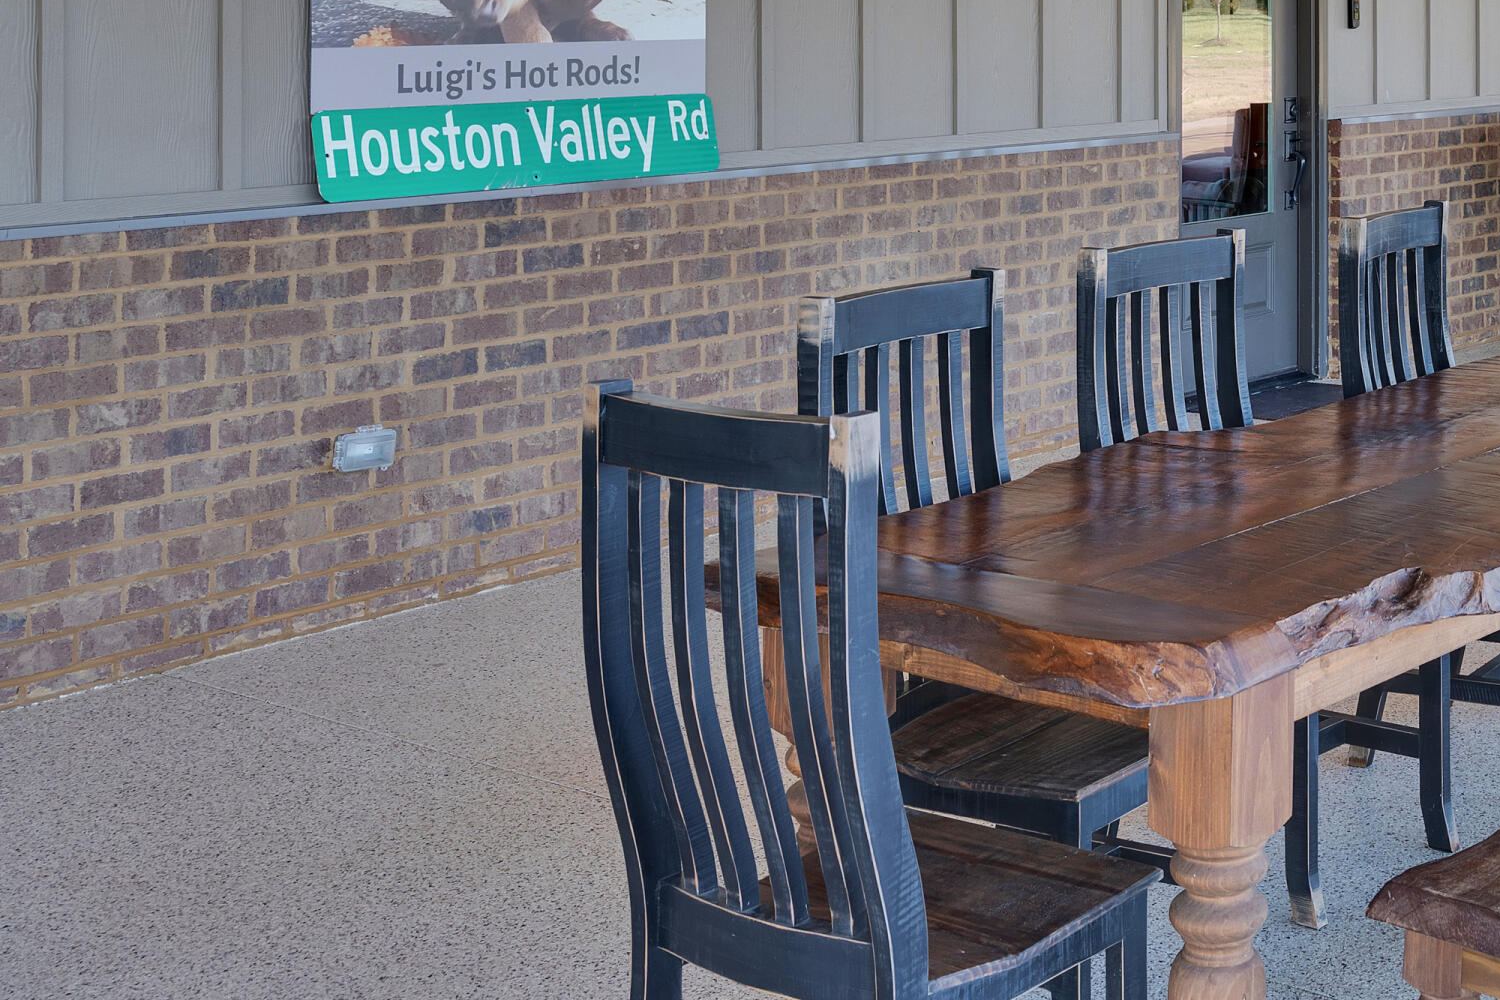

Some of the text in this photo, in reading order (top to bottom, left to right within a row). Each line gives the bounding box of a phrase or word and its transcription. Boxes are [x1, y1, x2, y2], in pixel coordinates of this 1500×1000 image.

[397, 55, 640, 100] Luigi's Hot Rods!
[321, 99, 710, 178] Houston Valley Rd
